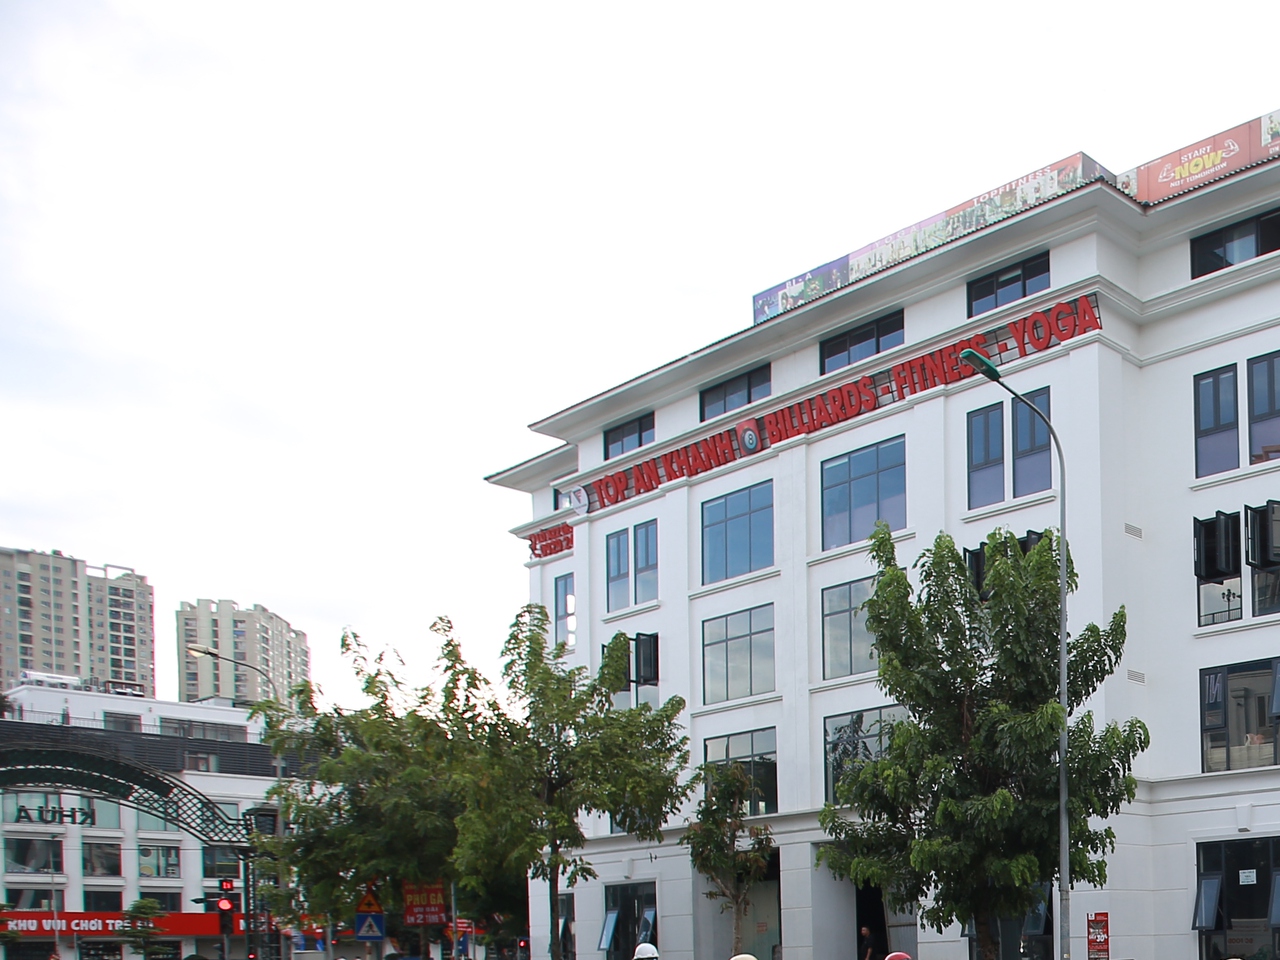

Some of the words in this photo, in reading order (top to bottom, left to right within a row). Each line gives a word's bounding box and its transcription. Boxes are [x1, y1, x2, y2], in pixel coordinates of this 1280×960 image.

[1174, 150, 1224, 179] NOW
[1181, 144, 1213, 163] START
[592, 470, 629, 509] TOP
[632, 457, 661, 496] AN
[661, 430, 737, 483] KHANH
[764, 376, 876, 445] BILLIARDS
[892, 334, 990, 401] FITNESS
[1007, 295, 1102, 358] YOGA
[7, 919, 38, 931] KHU
[71, 917, 103, 931] CHƠI
